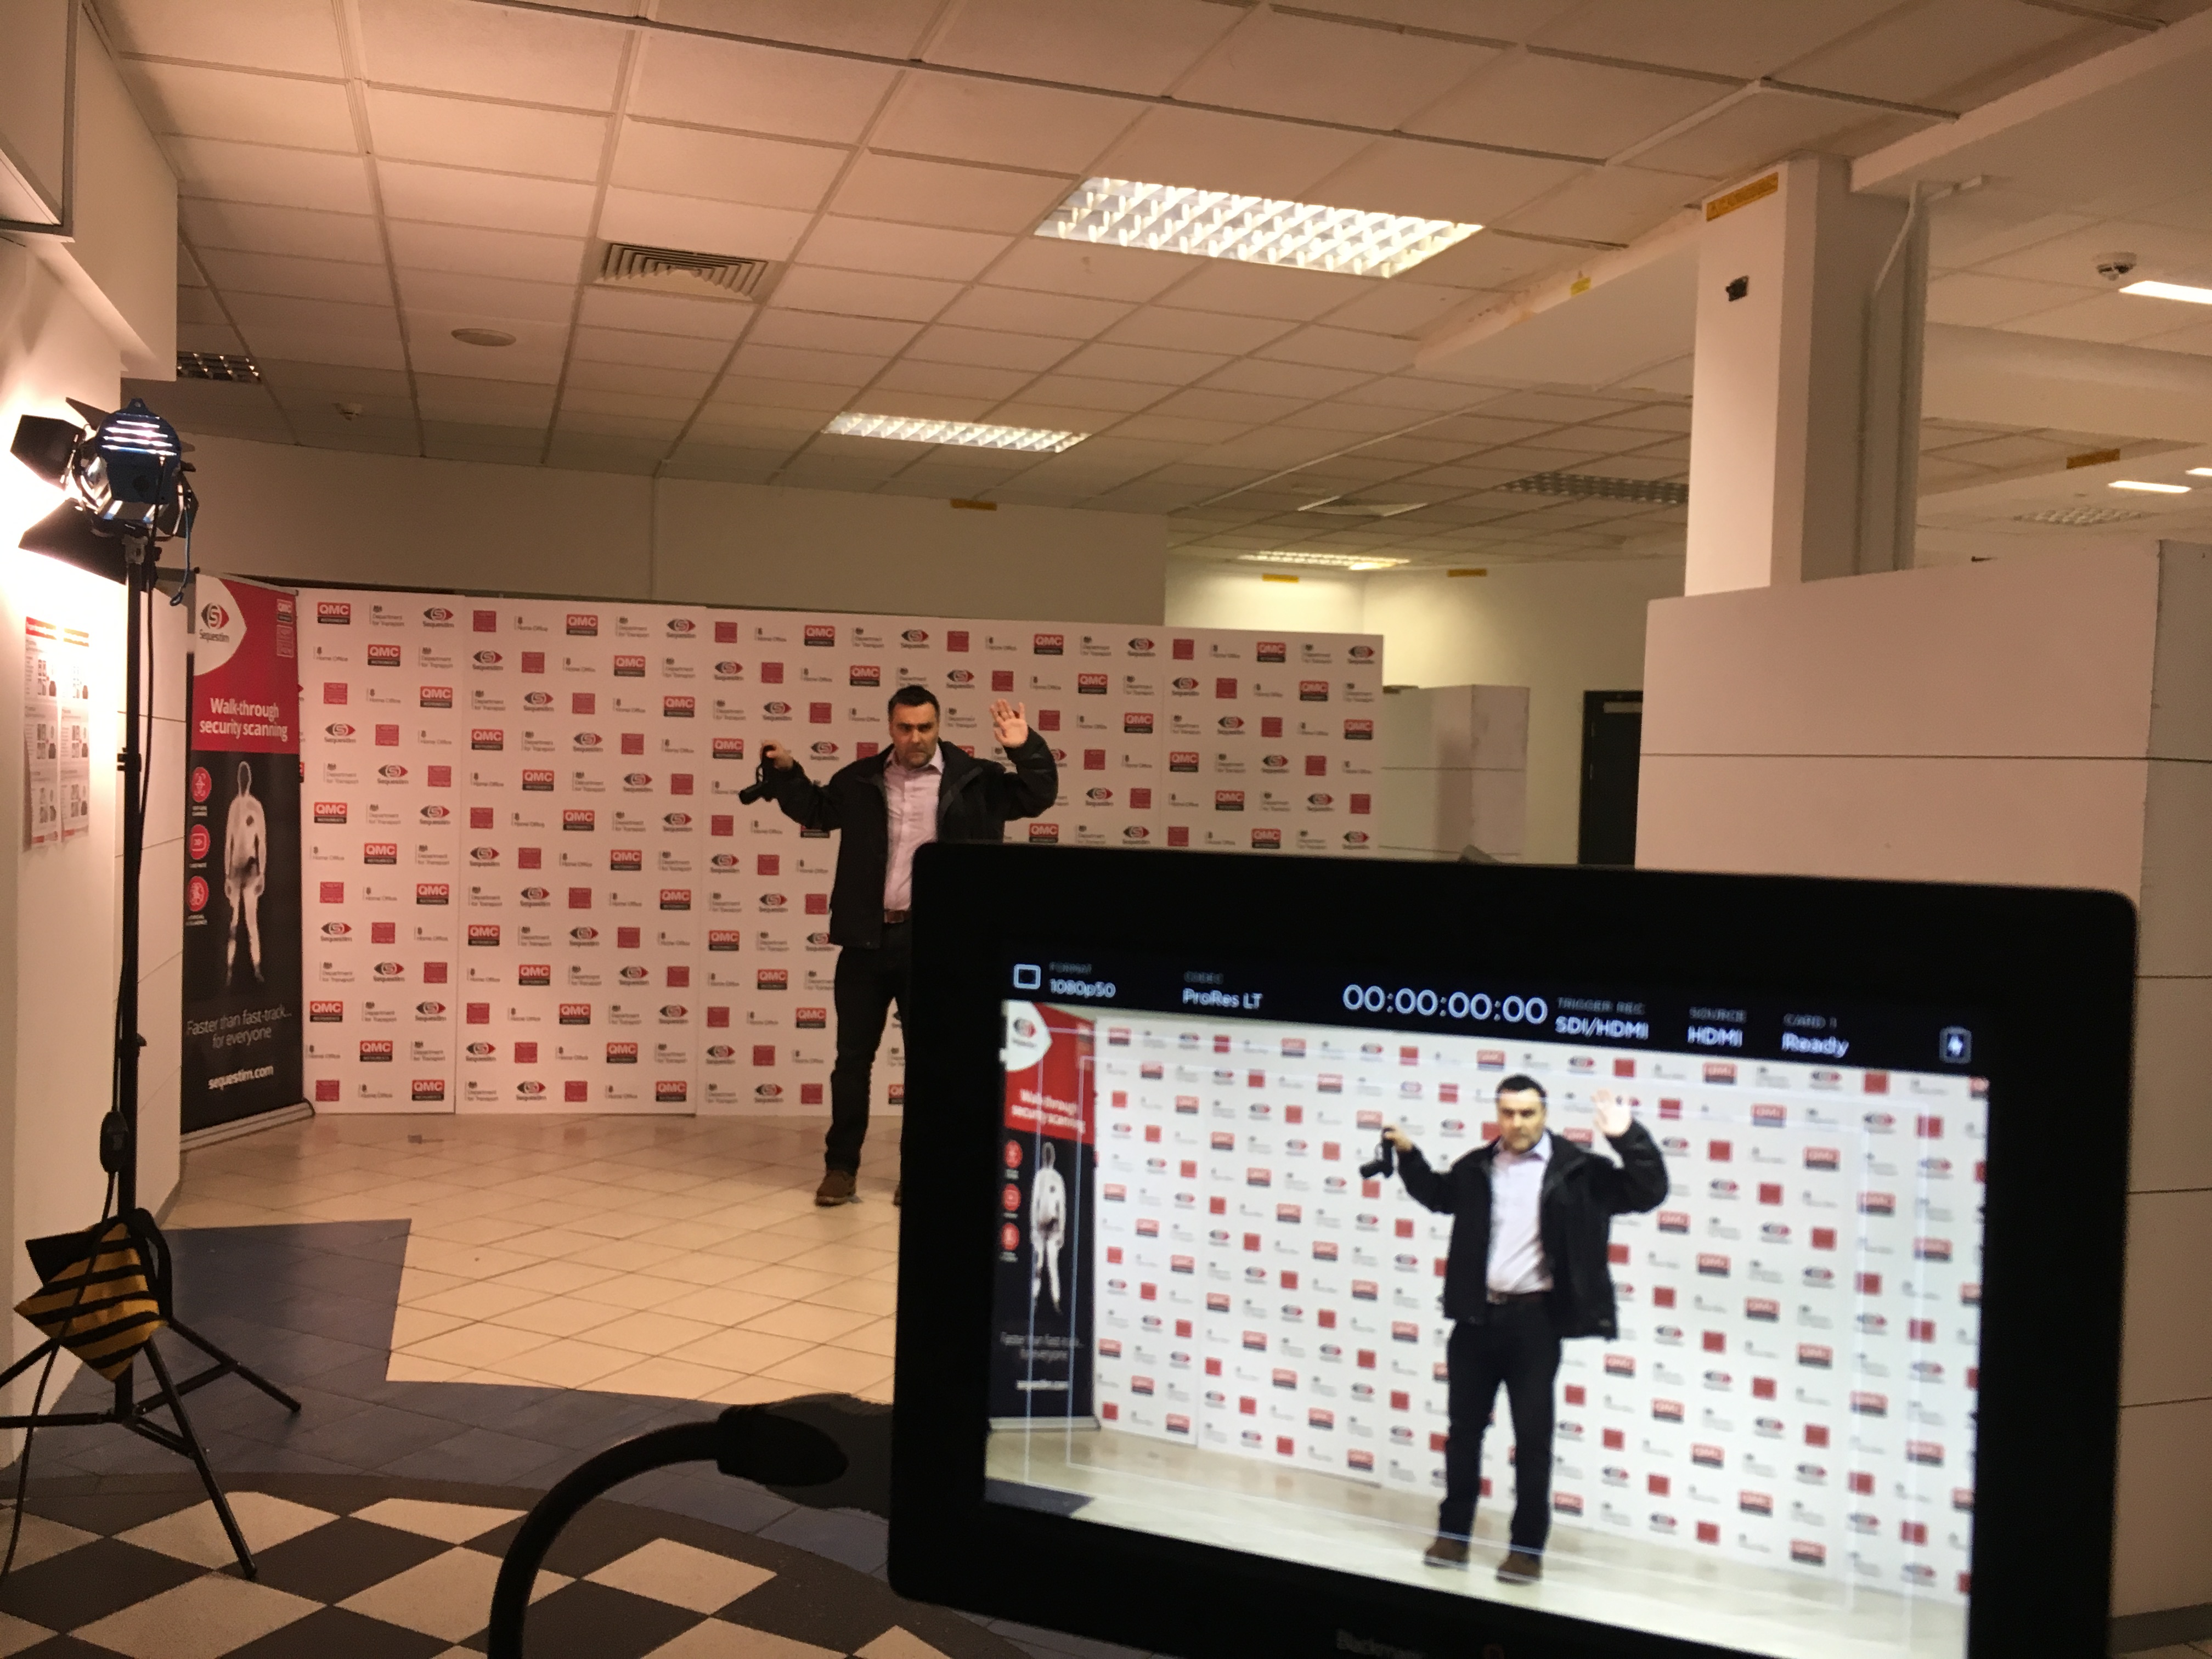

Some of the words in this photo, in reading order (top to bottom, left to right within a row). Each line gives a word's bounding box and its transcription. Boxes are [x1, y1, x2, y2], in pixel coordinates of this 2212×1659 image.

[319, 604, 349, 615] QMC
[567, 616, 596, 627] QMC
[805, 627, 833, 637] QMC
[1035, 636, 1063, 646] QMC
[369, 646, 399, 657] QMC
[616, 657, 644, 667] QMC
[850, 667, 879, 678] QMC
[1079, 675, 1107, 685] QMC
[422, 688, 451, 698] QMC
[664, 698, 693, 708] QMC
[210, 697, 279, 722] Walk-through
[200, 719, 242, 739] security
[242, 722, 288, 742] scanning
[473, 731, 502, 741] QMC
[713, 740, 742, 750] QMC
[524, 771, 552, 782] QMC
[315, 804, 346, 814] QMC
[565, 811, 593, 822] QMC
[1031, 825, 1058, 834] QMC
[365, 845, 395, 855] QMC
[611, 851, 640, 861] QMC
[418, 885, 447, 895] QMC
[662, 890, 690, 901] QMC
[470, 926, 498, 937] QMC
[709, 932, 738, 942] QMC
[520, 966, 549, 977] QMC
[758, 970, 787, 981] QMC
[1050, 978, 1116, 998] 1080p50
[1183, 988, 1240, 1008] ProRes
[1243, 992, 1263, 1009] LT
[312, 1002, 341, 1013] QMC
[561, 1005, 589, 1015] QMC
[1342, 984, 1549, 1025] 00:00:00:00
[796, 1009, 825, 1019] QMC
[187, 1020, 218, 1035] Faster
[220, 1015, 240, 1030] than
[1555, 1016, 1649, 1040] SDI/HDMI
[212, 1034, 224, 1048] for
[226, 1027, 272, 1046] everyone
[1688, 1025, 1743, 1048] HDMI
[362, 1042, 391, 1052] QMC
[608, 1044, 636, 1054] QMC
[1781, 1031, 1849, 1059] Ready
[208, 1065, 274, 1091] sequestim.com
[414, 1081, 443, 1092] QMC
[657, 1082, 685, 1093] QMC
